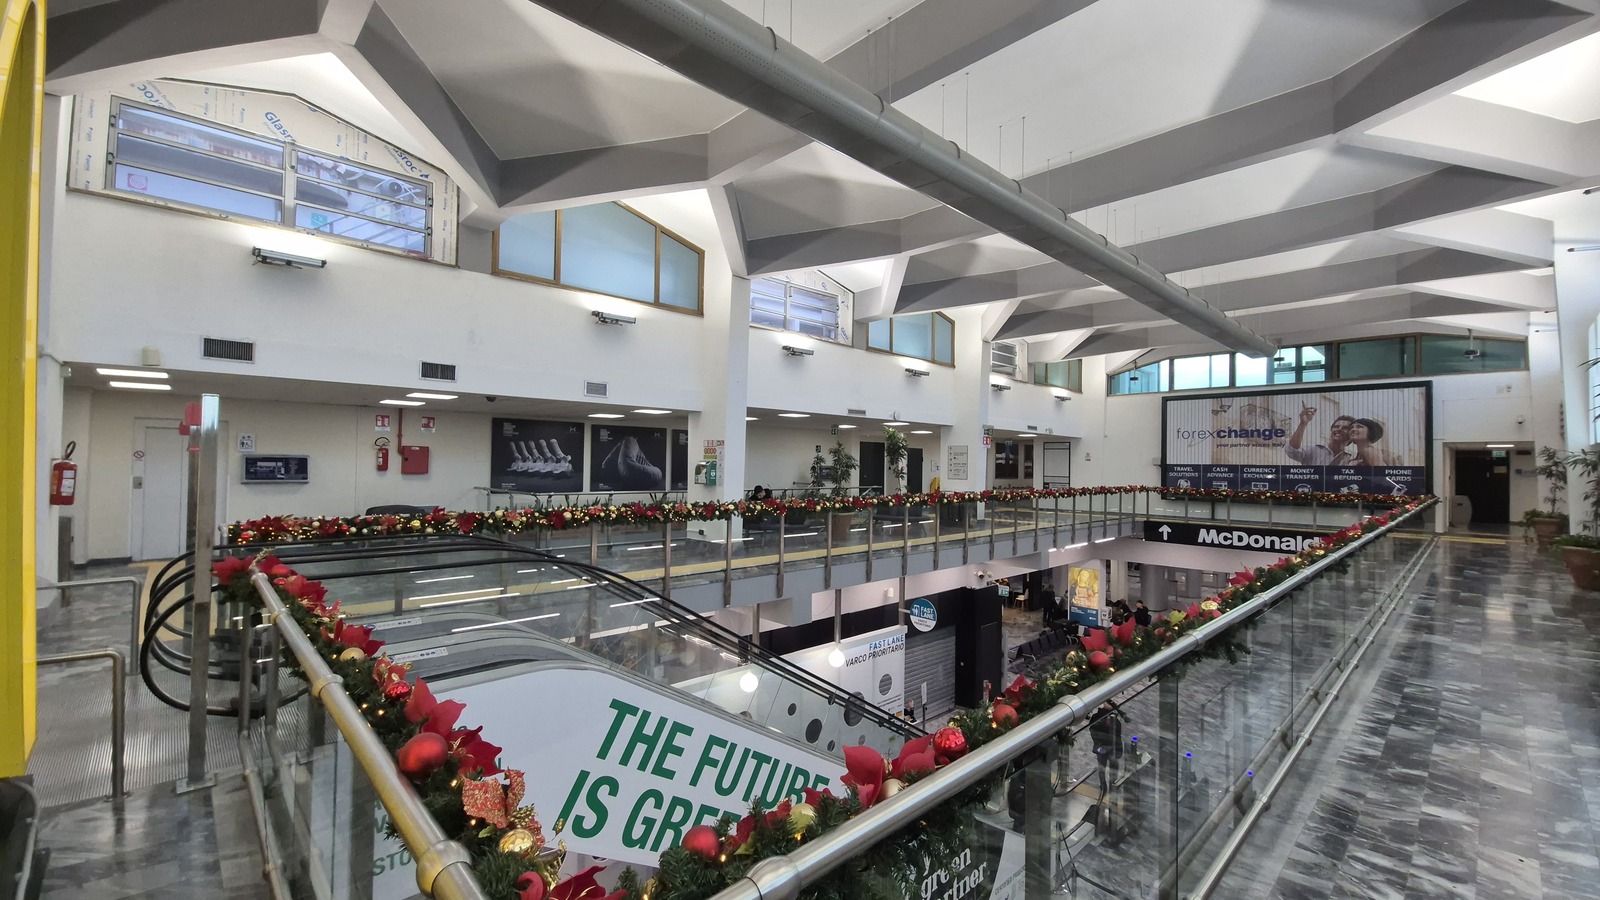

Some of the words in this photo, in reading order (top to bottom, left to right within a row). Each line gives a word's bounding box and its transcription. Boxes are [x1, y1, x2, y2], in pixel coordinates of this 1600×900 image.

[1176, 427, 1286, 441] forexchange
[920, 606, 934, 614] FAST
[868, 639, 886, 652] FAST
[887, 634, 904, 646] LANE
[845, 653, 867, 667] VARCO
[868, 643, 905, 661] PRIORITARIO
[596, 698, 694, 781] THE
[552, 769, 620, 839] IS
